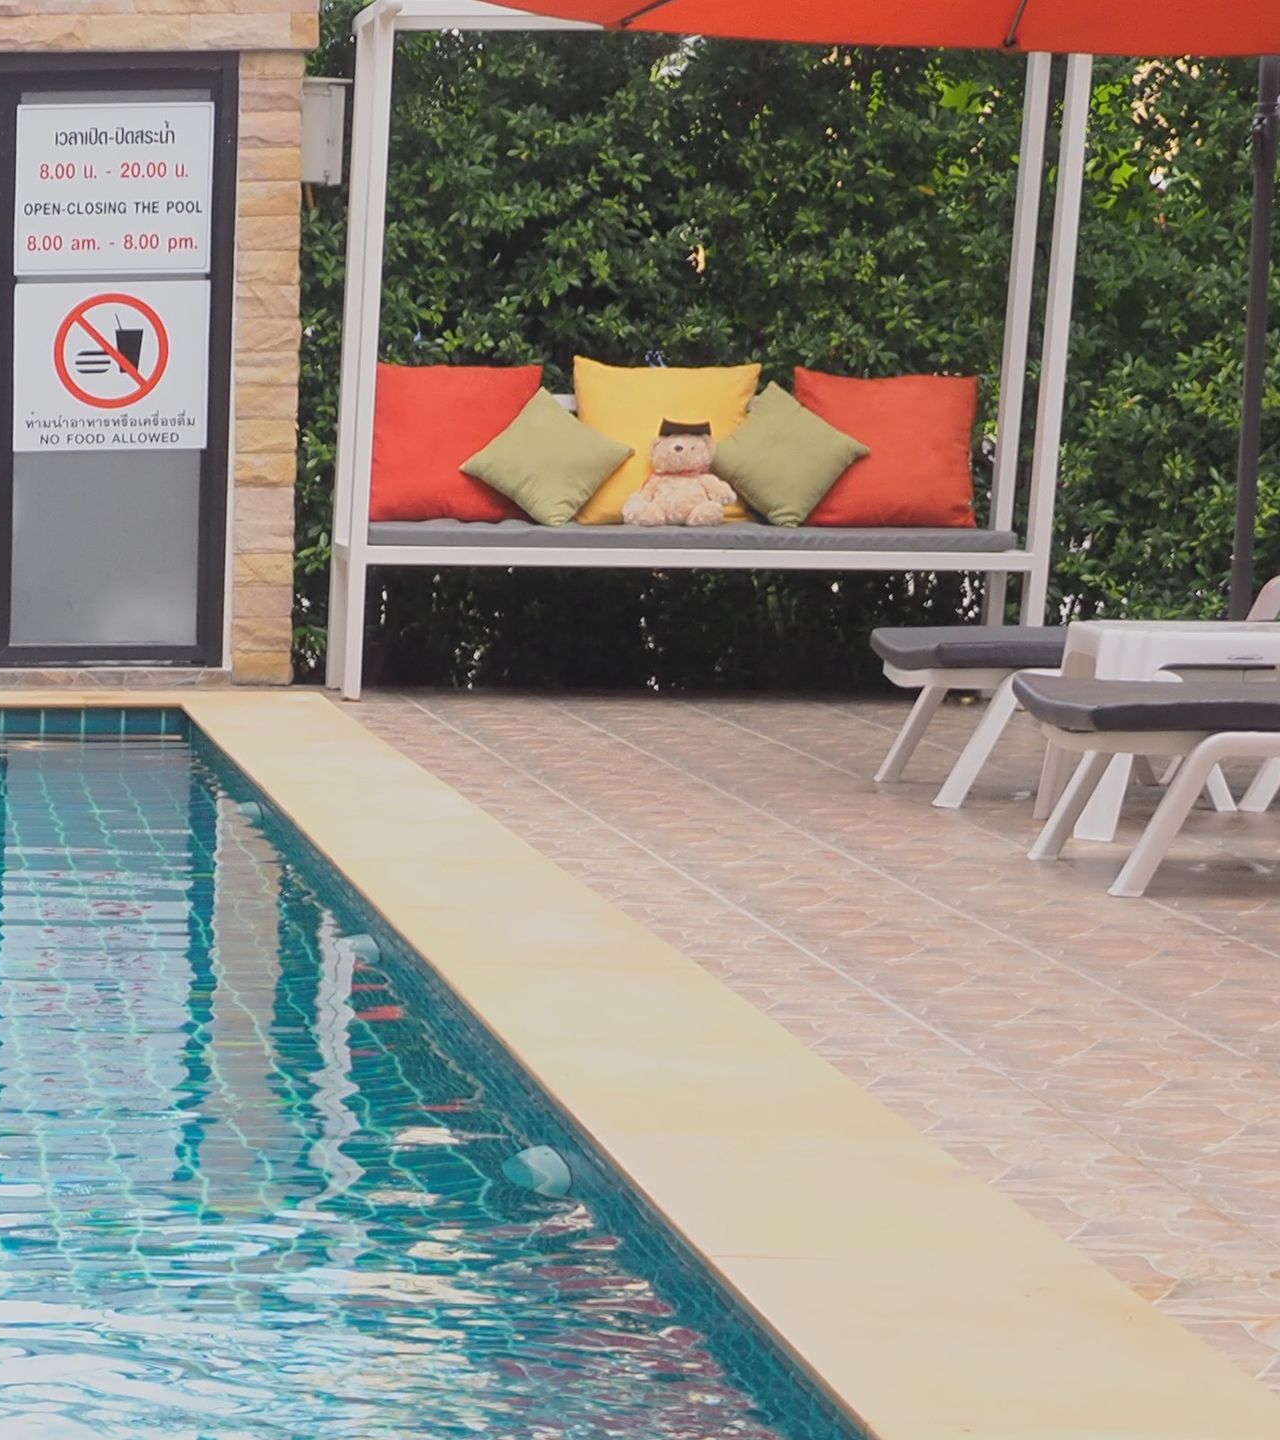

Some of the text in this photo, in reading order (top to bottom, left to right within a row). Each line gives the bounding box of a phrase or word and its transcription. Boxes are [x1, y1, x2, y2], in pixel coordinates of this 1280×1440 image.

[55, 121, 175, 146] เวลาเปิด-ปิดสระน้ำ
[40, 163, 75, 179] 8.00
[84, 165, 97, 179] น.
[120, 162, 166, 178] 20.00
[175, 164, 188, 177] น.
[24, 201, 202, 215] OPEN-CLOSING THE POOL
[27, 235, 63, 251] 8.00
[71, 238, 100, 251] am.
[123, 234, 159, 249] 8.00
[168, 237, 198, 252] pm.
[40, 432, 179, 444] NO FOOD ALLOWED
